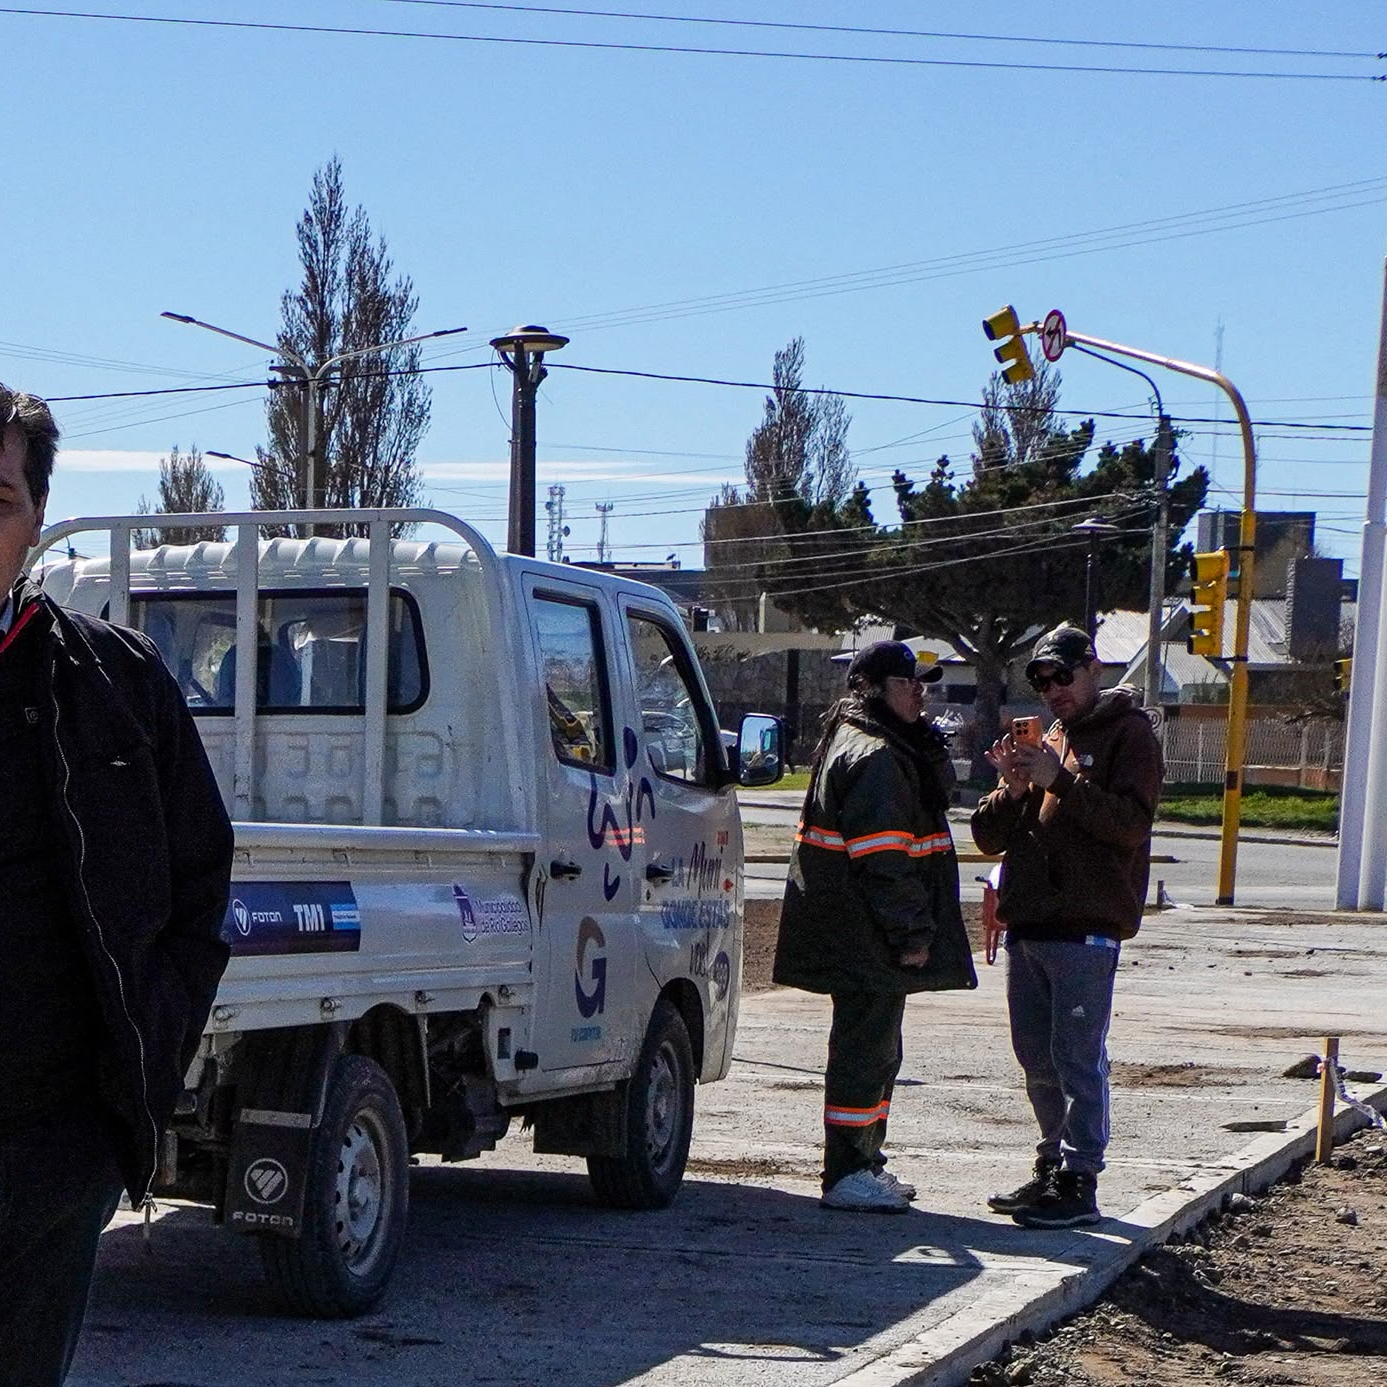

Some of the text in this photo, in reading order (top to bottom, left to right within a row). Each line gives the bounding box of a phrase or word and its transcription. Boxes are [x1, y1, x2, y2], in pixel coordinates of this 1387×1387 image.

[251, 904, 325, 932] FOTON TM1
[575, 916, 607, 1018] G
[232, 1211, 294, 1226] FOTON
